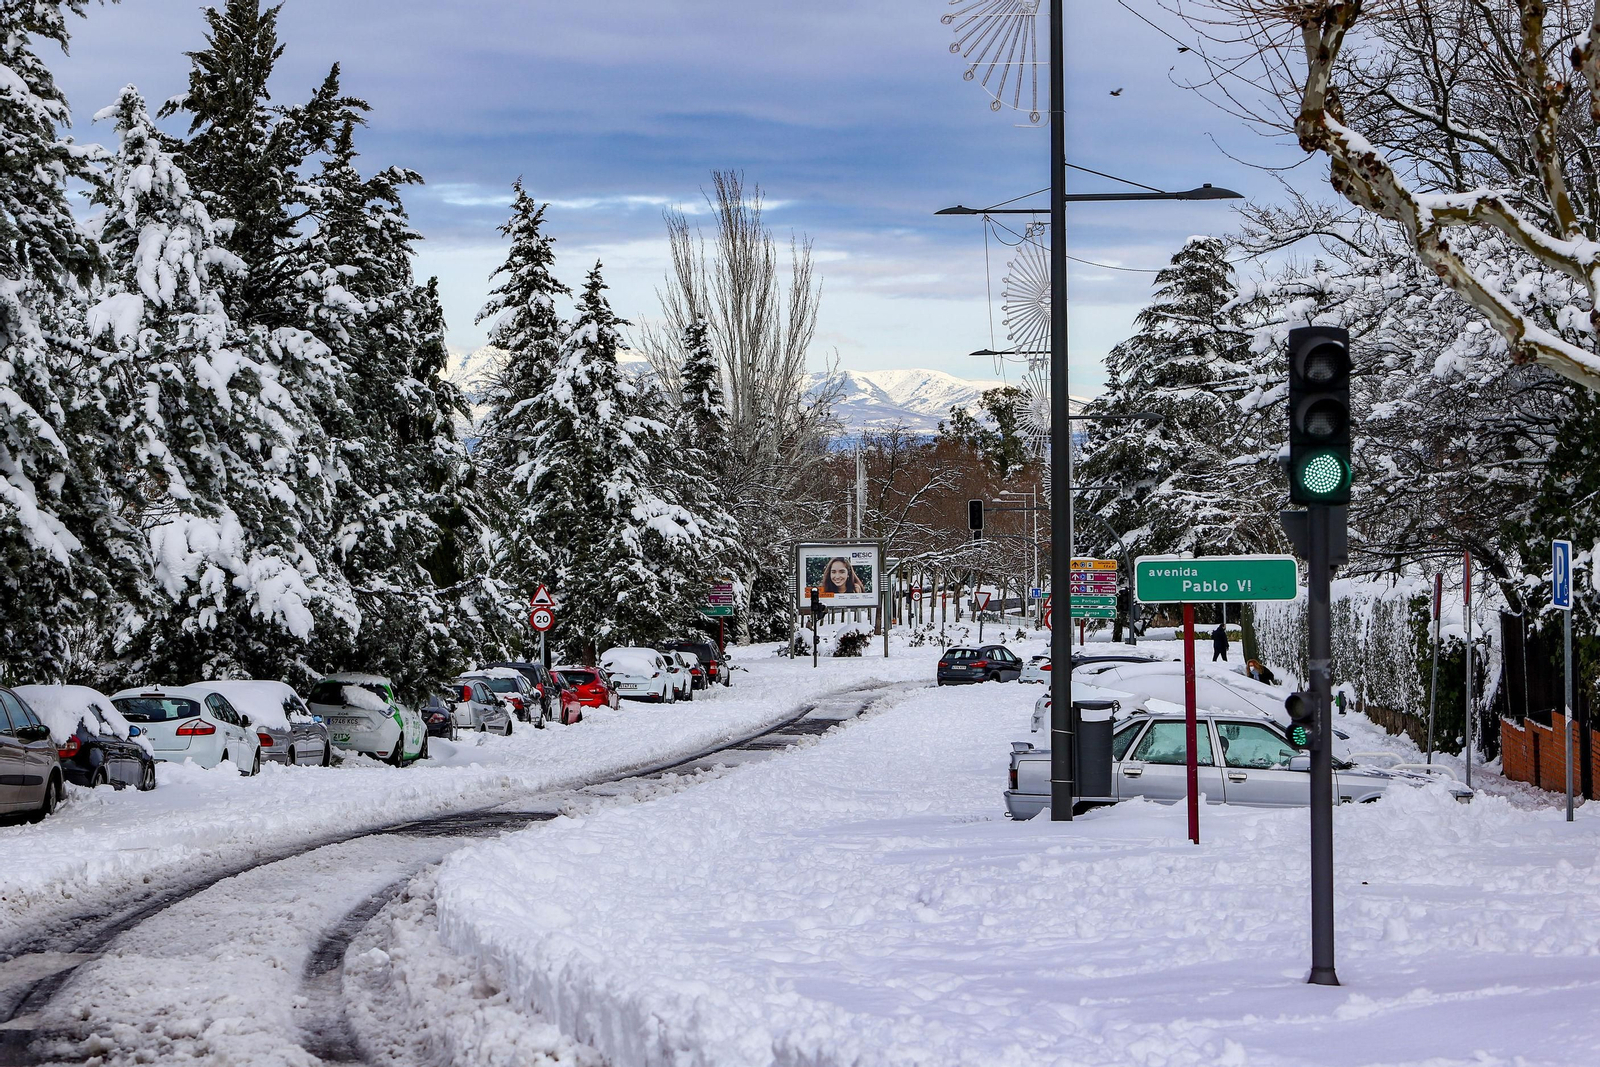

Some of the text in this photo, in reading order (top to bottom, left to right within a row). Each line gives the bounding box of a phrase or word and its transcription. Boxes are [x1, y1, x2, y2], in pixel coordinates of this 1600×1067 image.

[1148, 566, 1198, 577] avenida
[1556, 546, 1564, 599] P
[1182, 579, 1252, 592] Pablo VI
[536, 615, 549, 623] 20
